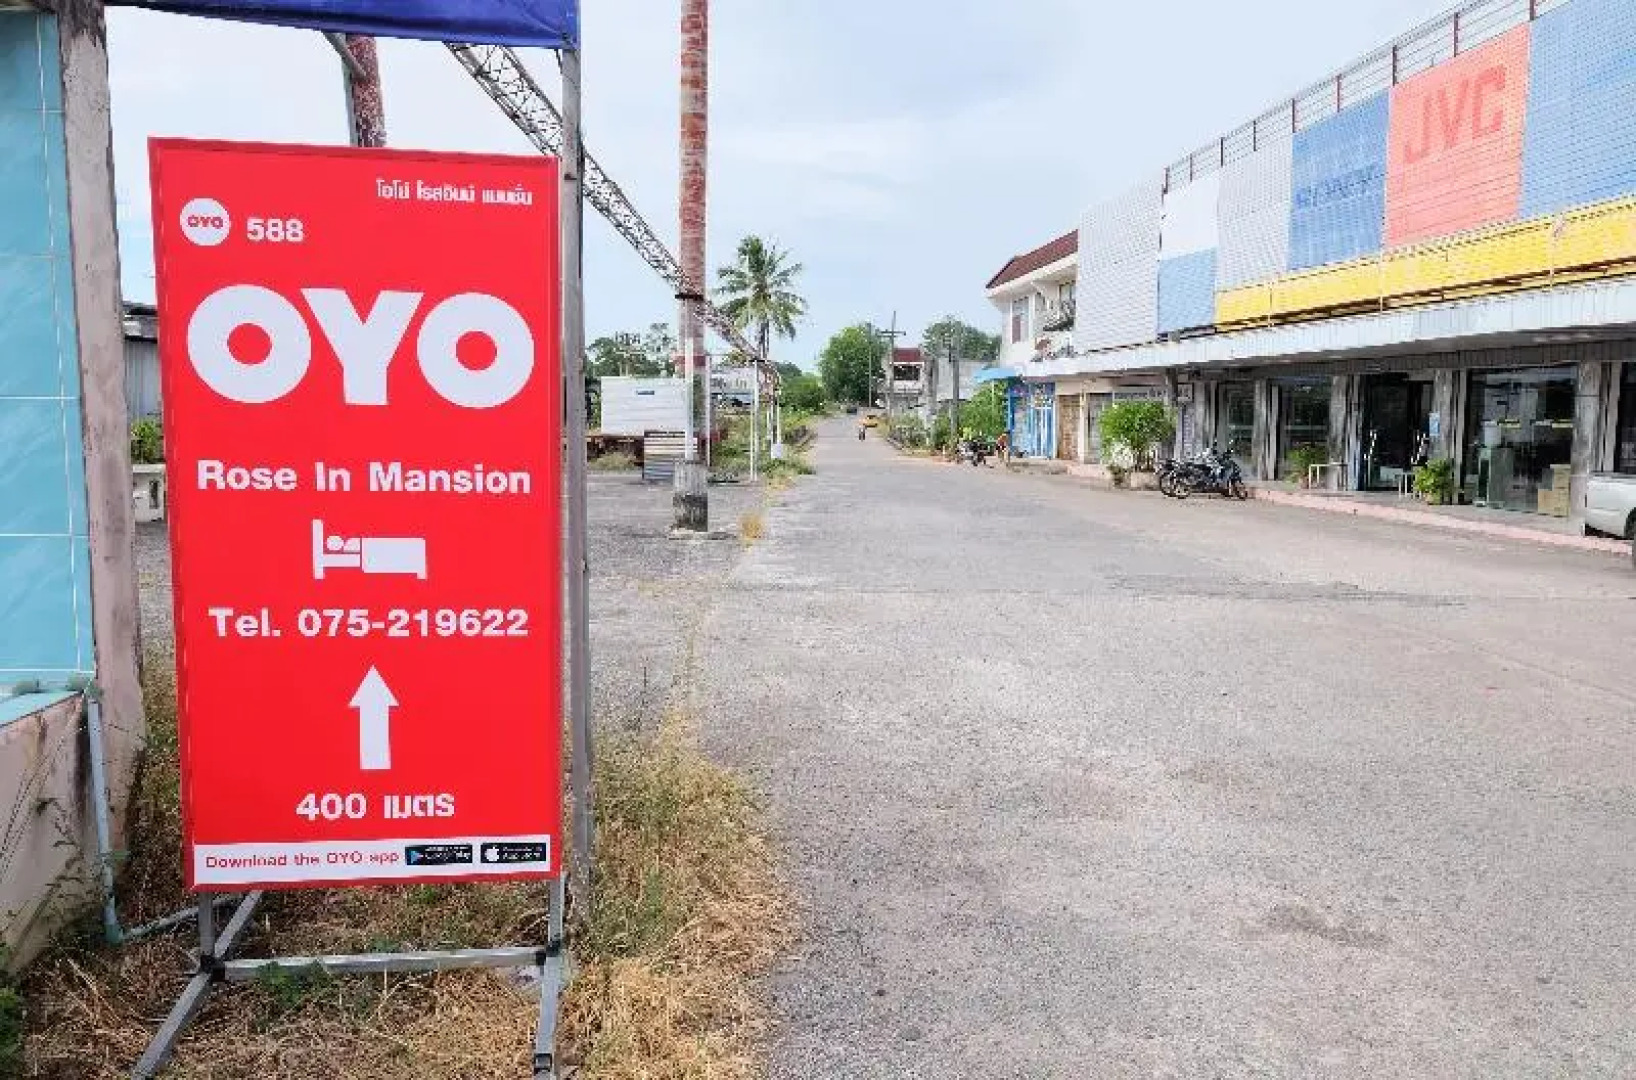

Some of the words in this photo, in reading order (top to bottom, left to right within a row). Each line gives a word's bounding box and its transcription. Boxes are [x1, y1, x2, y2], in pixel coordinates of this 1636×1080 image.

[1404, 65, 1506, 164] JVC
[187, 214, 224, 229] OYO
[246, 217, 304, 242] 588
[187, 283, 535, 409] OYO
[197, 459, 298, 491] Rose
[314, 461, 351, 492] In
[369, 461, 531, 494] Mansion
[208, 607, 281, 637] Tel.
[297, 608, 529, 637] 075-219622
[295, 793, 367, 821] 400
[383, 793, 455, 819] เมตร
[205, 854, 287, 868] Download
[293, 852, 320, 866] the
[326, 850, 363, 864] OYO
[369, 852, 400, 866] app
